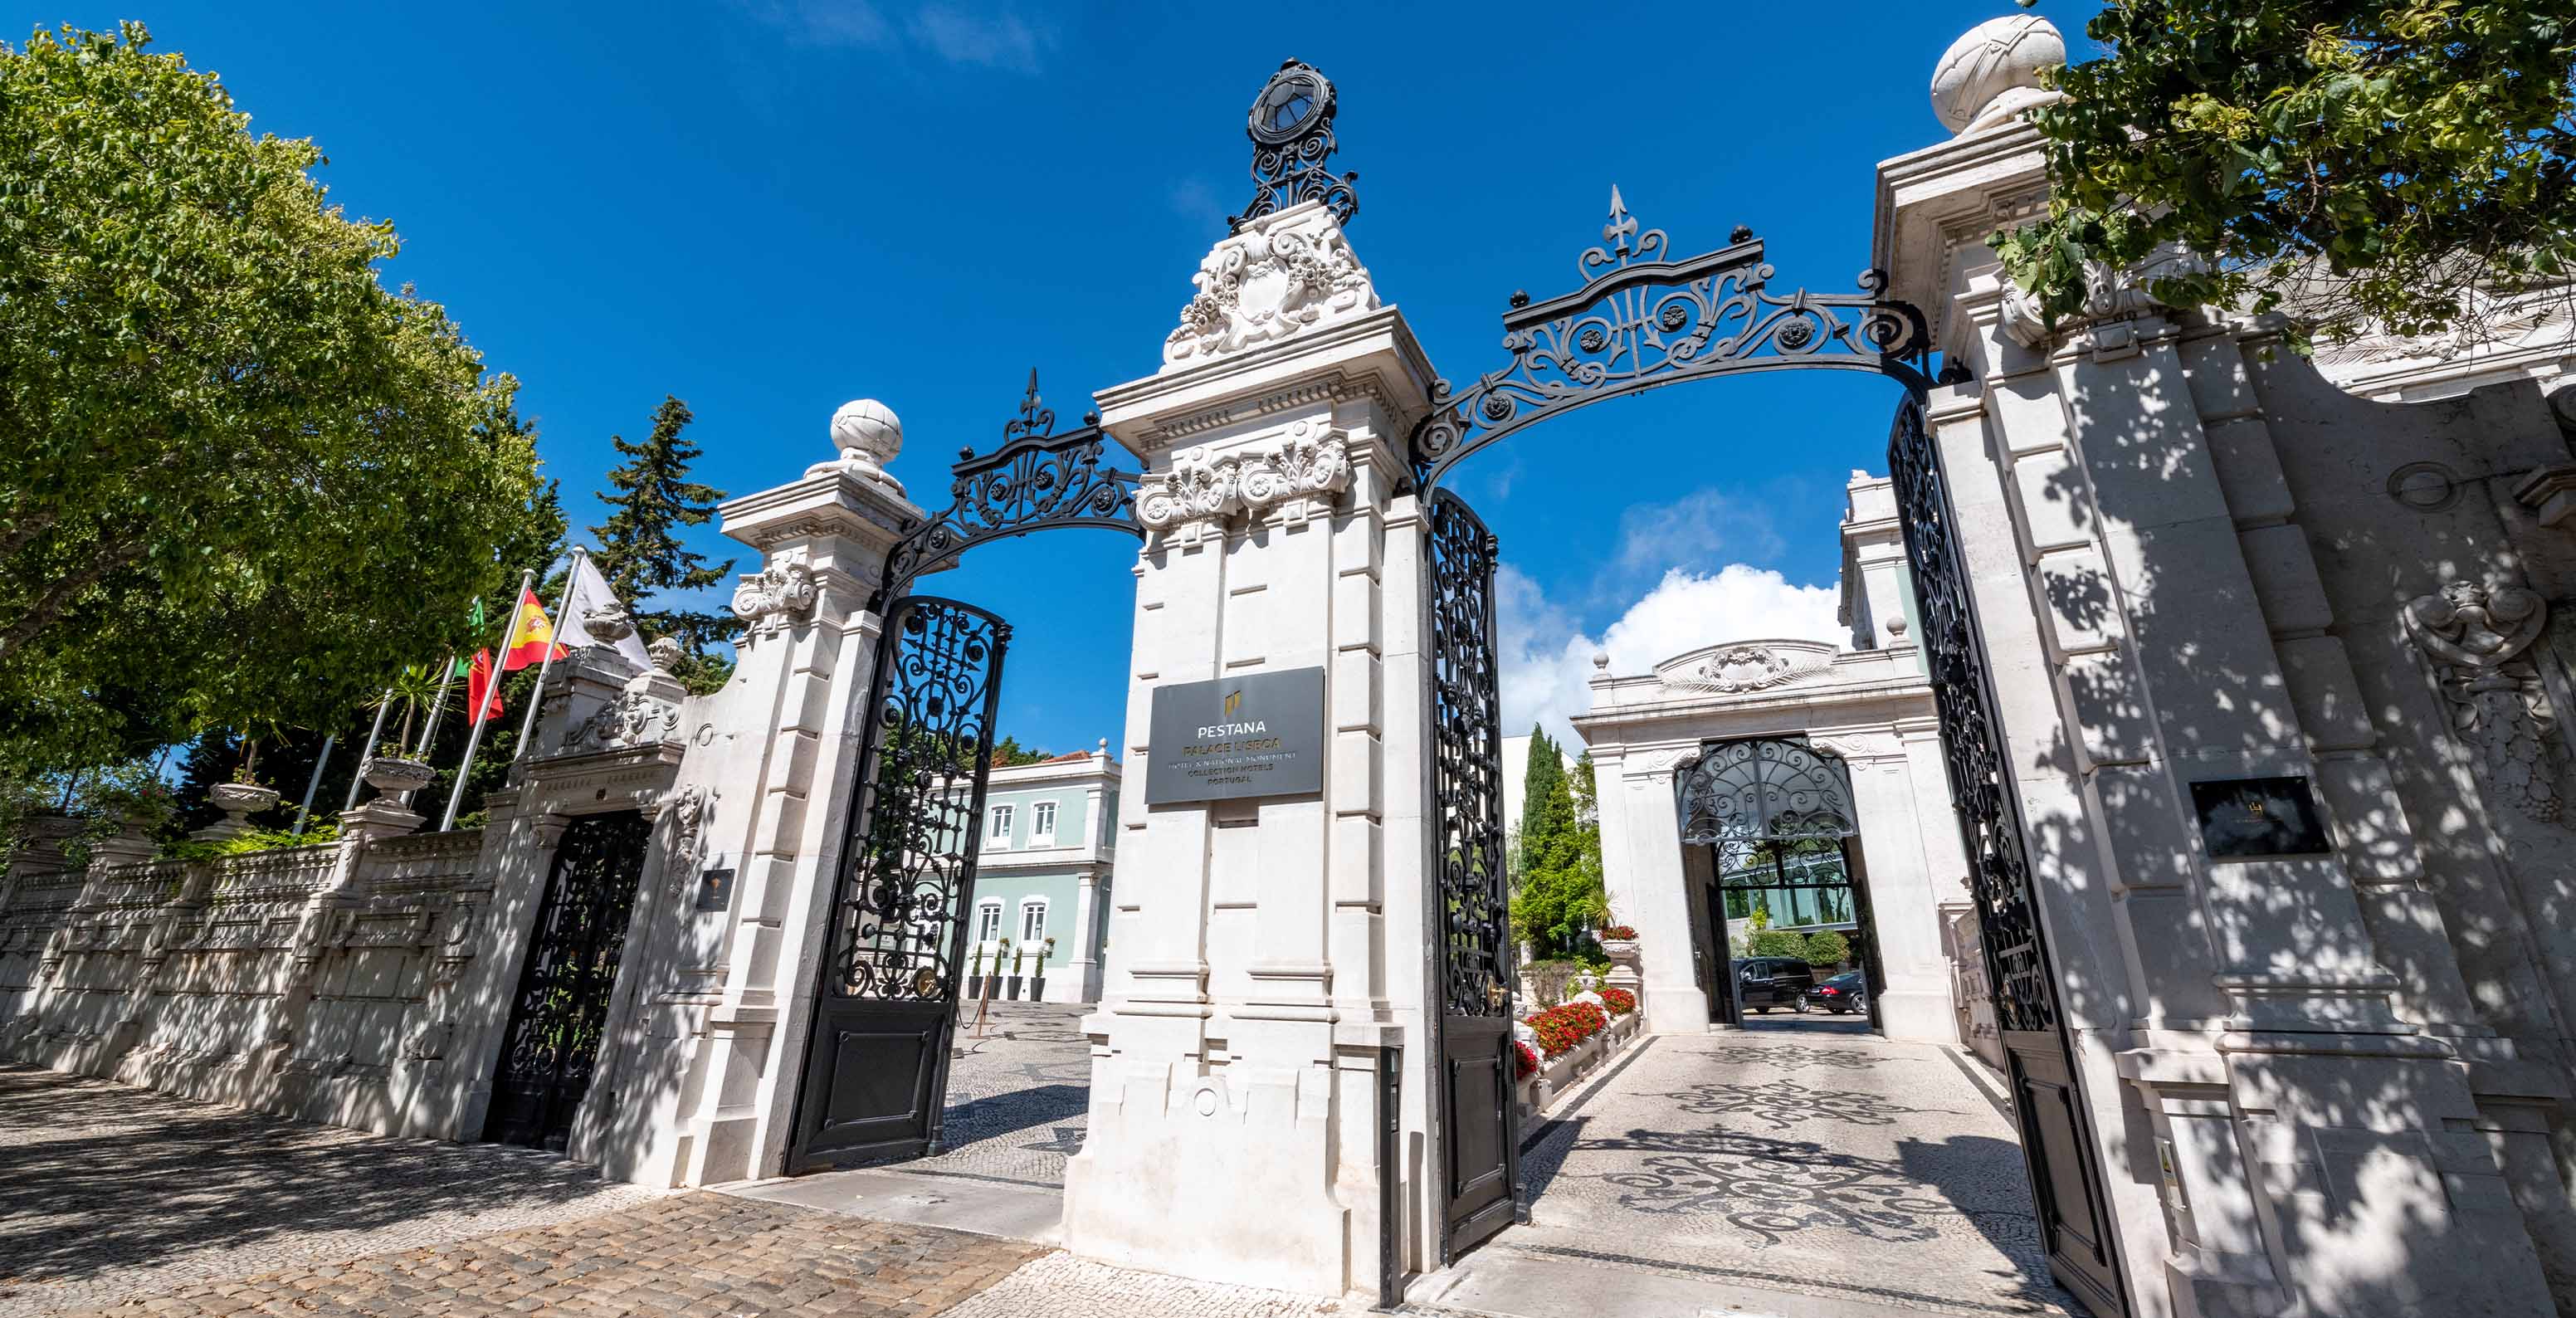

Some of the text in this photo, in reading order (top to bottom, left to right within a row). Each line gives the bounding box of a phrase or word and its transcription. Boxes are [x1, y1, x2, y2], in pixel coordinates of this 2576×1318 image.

[1198, 720, 1266, 739] PESTANA
[1182, 736, 1281, 757] PALACE LISBOA
[1188, 763, 1274, 777] COLLECTION HOTELS
[1208, 776, 1252, 786] PORTUGAL
